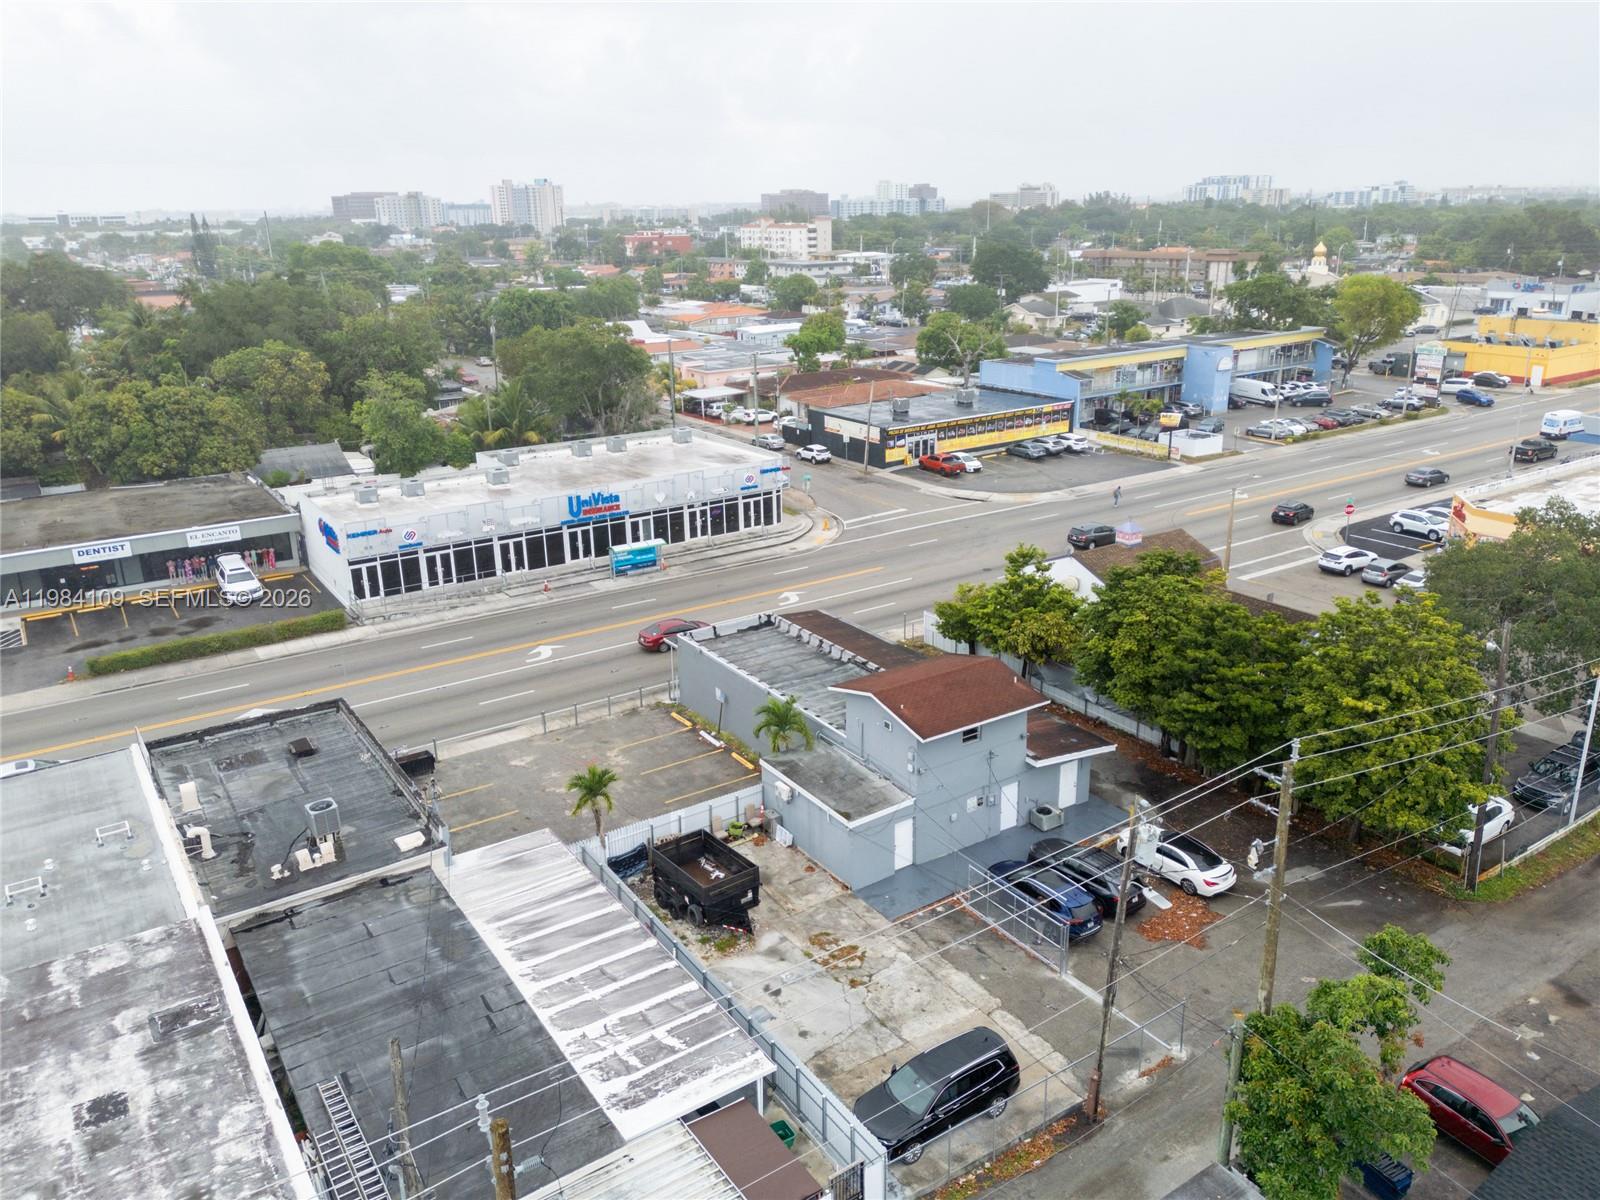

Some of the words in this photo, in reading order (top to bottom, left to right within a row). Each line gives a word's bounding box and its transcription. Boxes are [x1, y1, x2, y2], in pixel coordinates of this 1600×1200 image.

[567, 492, 620, 518] UniVista
[201, 529, 238, 538] ENCANTO
[77, 544, 126, 557] DENTIST
